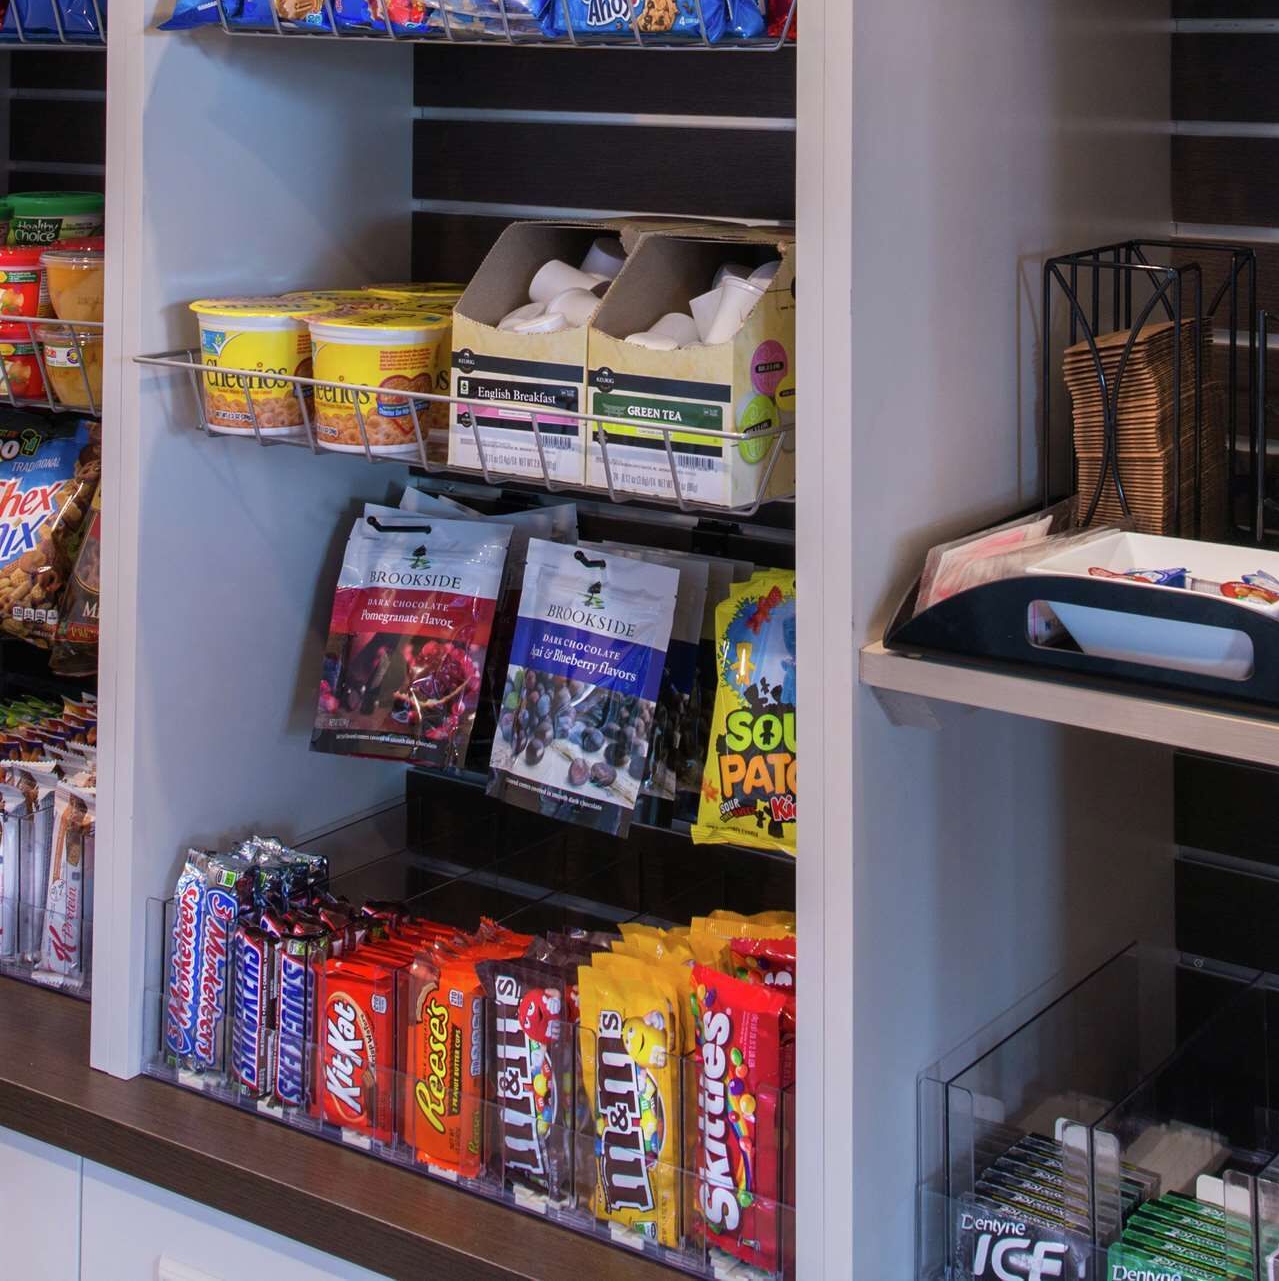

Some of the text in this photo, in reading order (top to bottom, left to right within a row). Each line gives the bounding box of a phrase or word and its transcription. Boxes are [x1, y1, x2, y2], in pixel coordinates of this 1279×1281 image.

[15, 229, 56, 242] Choice
[17, 220, 59, 232] Healthy
[206, 359, 288, 389] Cheerios
[478, 386, 556, 405] English Breakfast
[627, 406, 682, 422] GREEN TEA
[369, 570, 462, 590] BROOKSIDE
[367, 597, 449, 612] DARK CHOCOLATE
[361, 610, 418, 625] Pomegranate
[546, 604, 637, 638] BROOKSIDE
[542, 633, 621, 661] DARK CHOCOLATE
[552, 650, 599, 674] Blueberry
[599, 660, 637, 682] flavors
[720, 798, 740, 814] SOUR
[62, 887, 77, 939] Protein
[197, 916, 228, 1062] Musketeers
[415, 999, 451, 1134] Reese's
[699, 1010, 741, 1232] Skittles
[961, 1214, 1026, 1236] Dentyne
